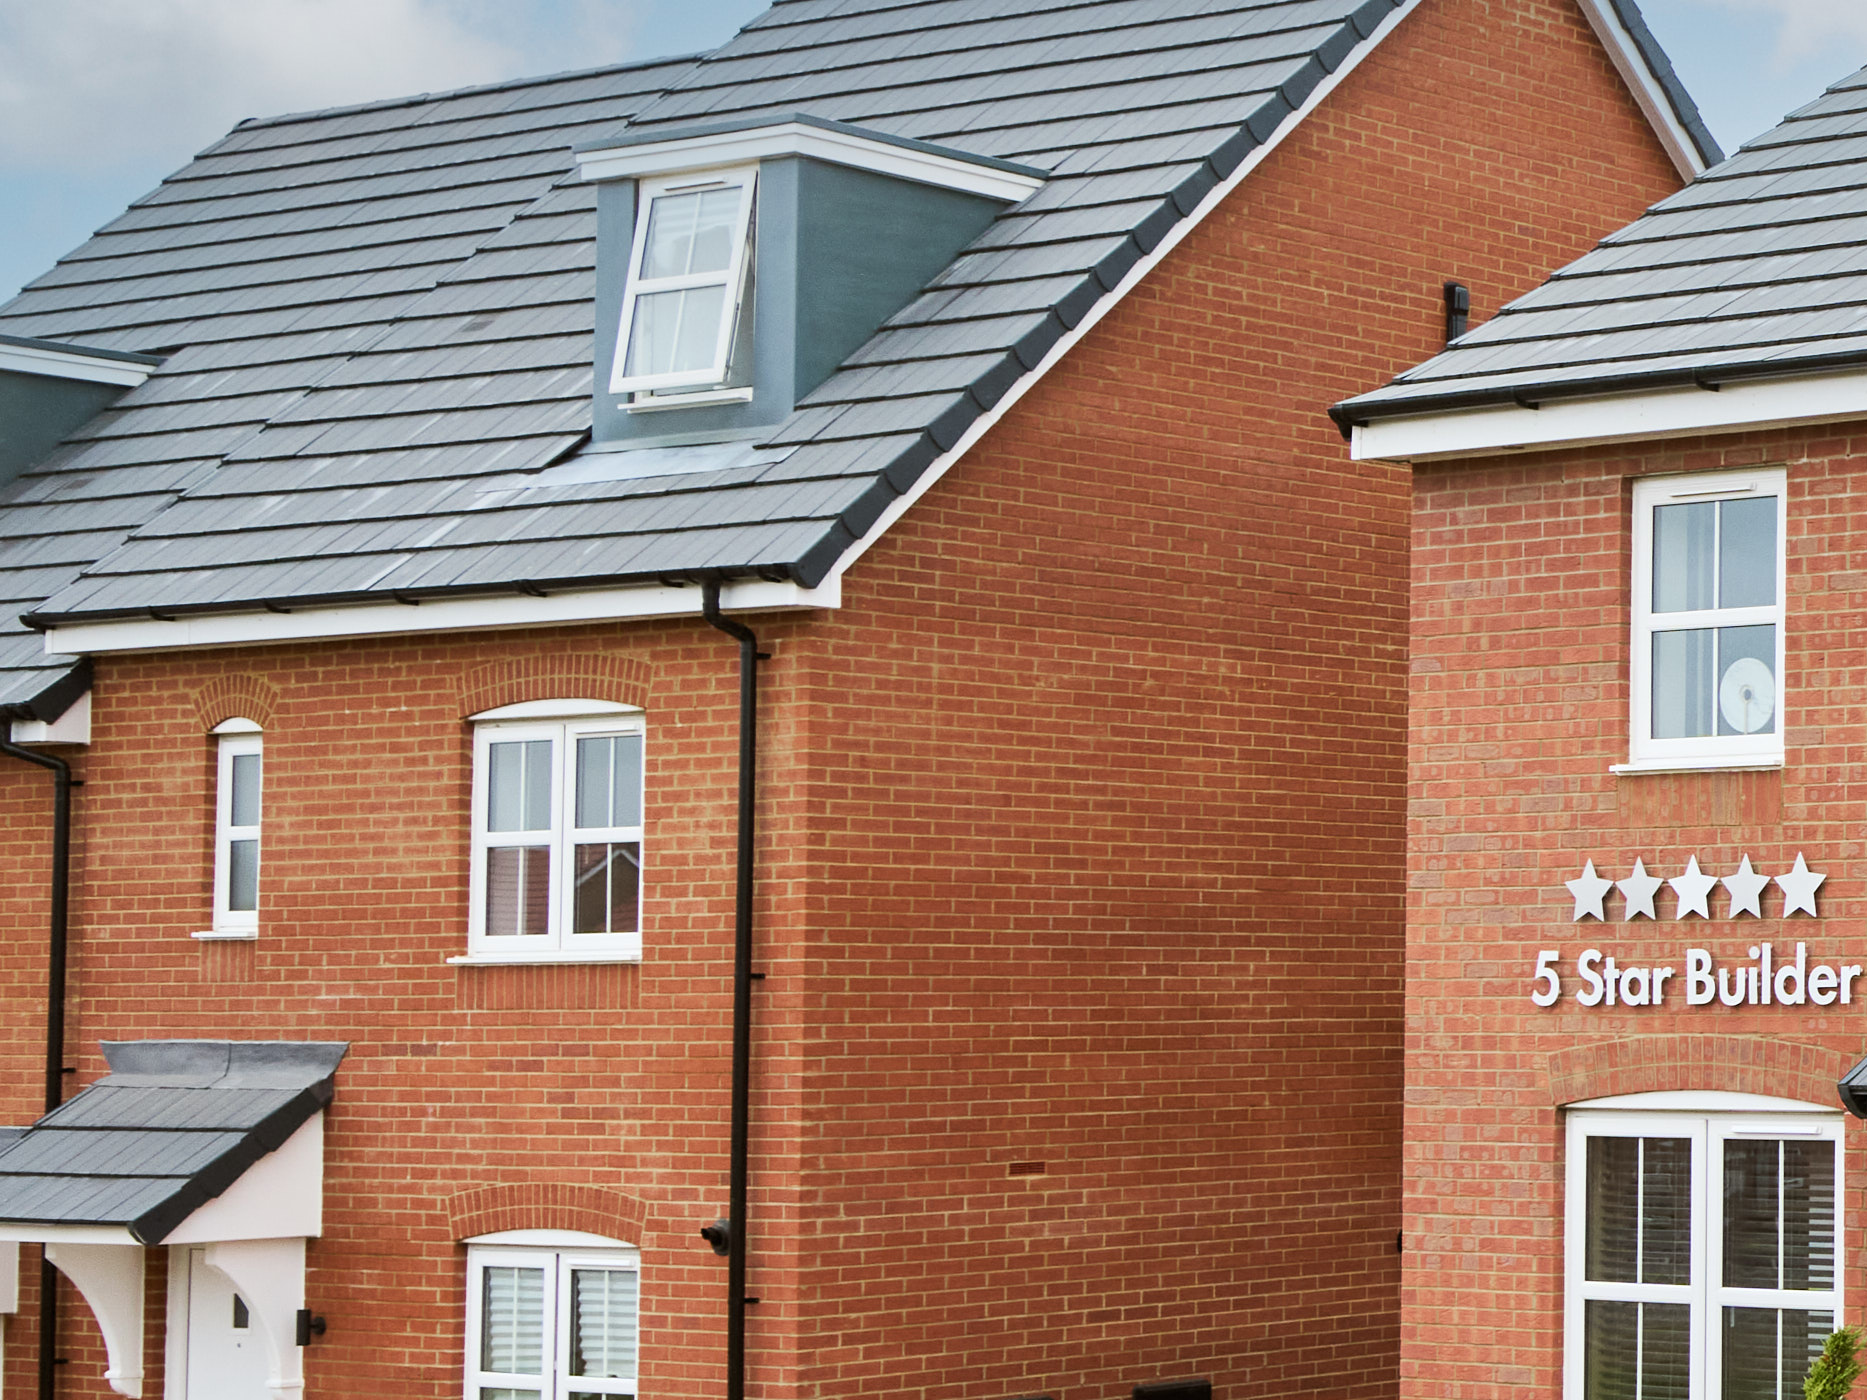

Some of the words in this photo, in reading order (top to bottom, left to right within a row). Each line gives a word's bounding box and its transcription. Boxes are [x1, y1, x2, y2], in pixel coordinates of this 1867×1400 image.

[1531, 950, 1560, 1007] 5
[1576, 948, 1673, 1007] Star
[1686, 941, 1862, 1007] Builder
